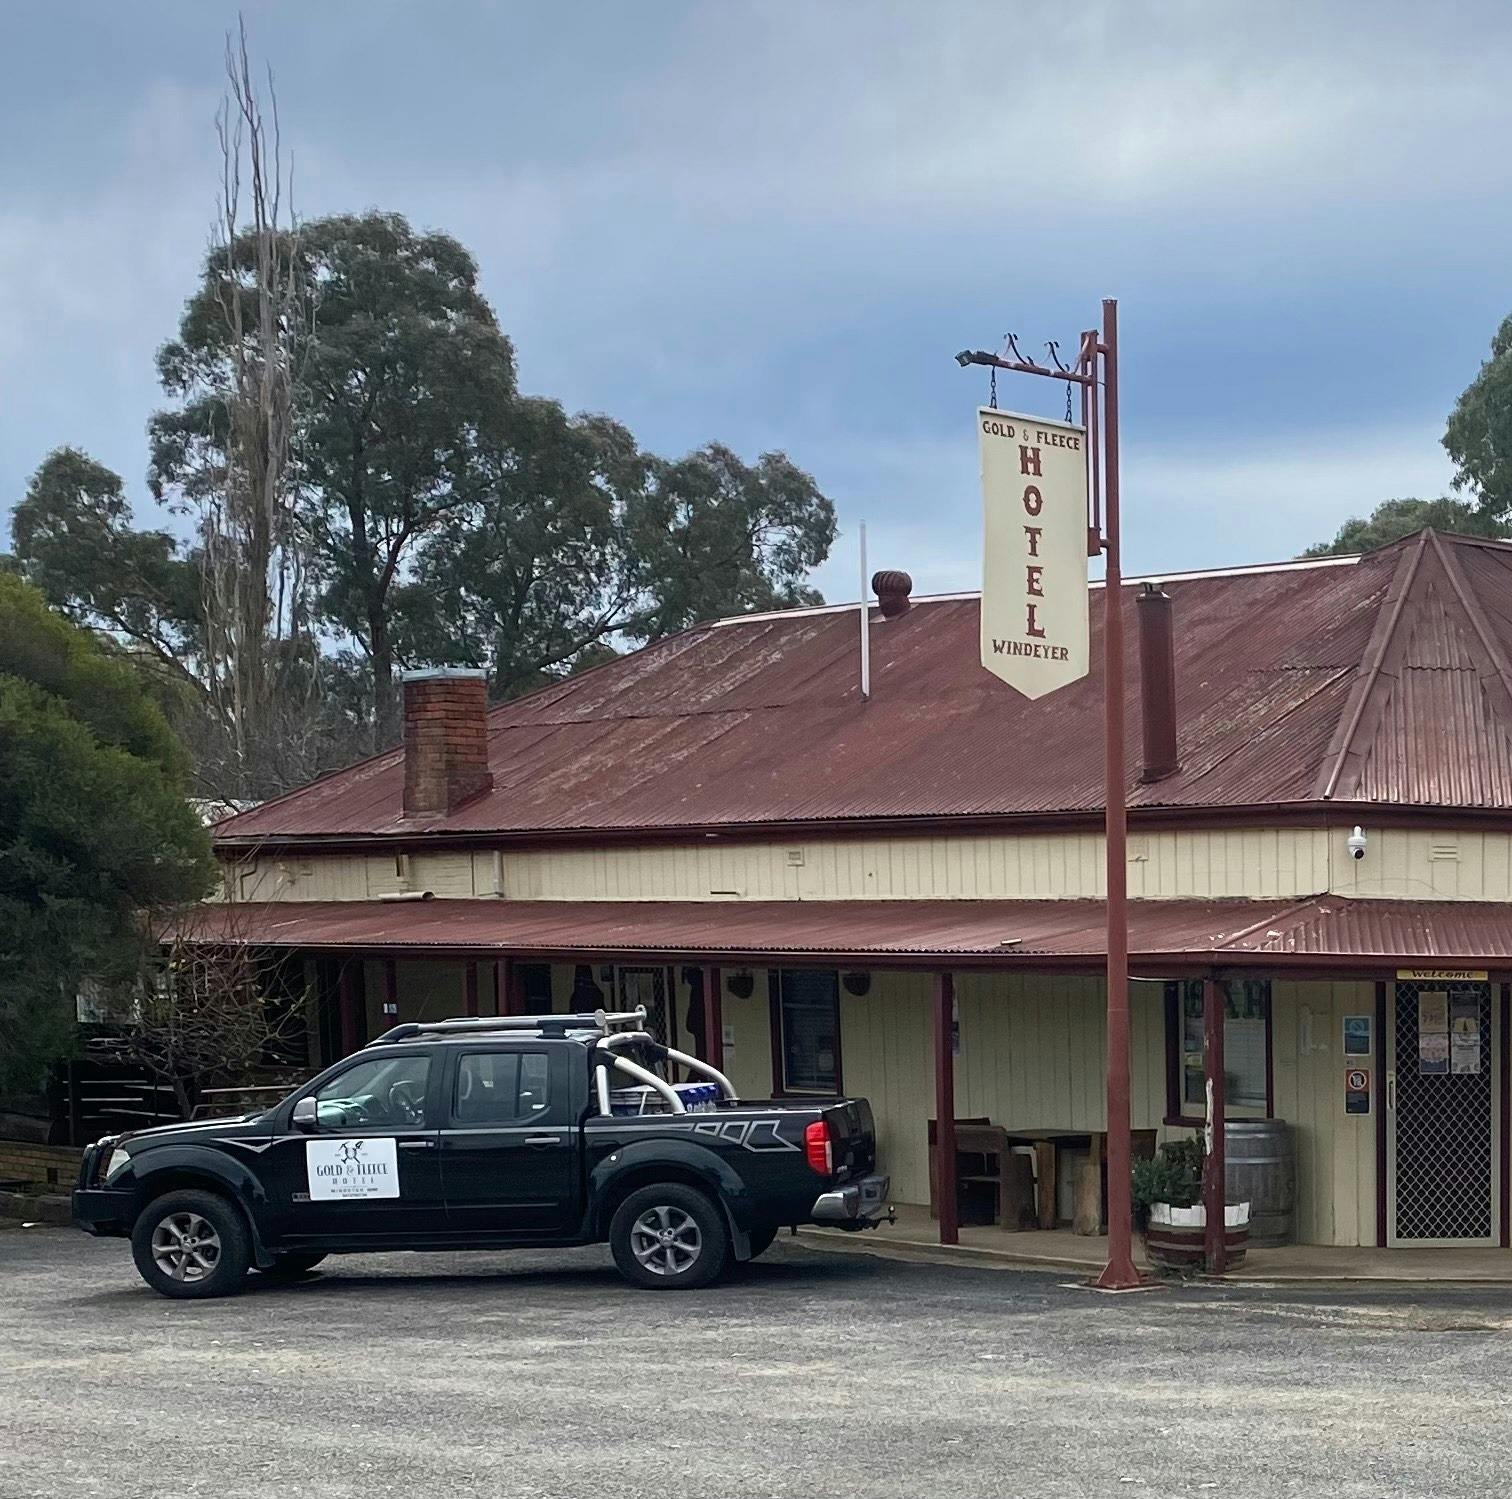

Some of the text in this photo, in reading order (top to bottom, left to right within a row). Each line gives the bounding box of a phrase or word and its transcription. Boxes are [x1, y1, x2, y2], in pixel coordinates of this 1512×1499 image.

[983, 421, 1080, 450] GOLD & FLEECE
[1018, 444, 1046, 639] HOTEL
[992, 639, 1069, 661] WINDEYER
[1412, 969, 1474, 979] Welcome
[316, 1165, 343, 1176] GOLD
